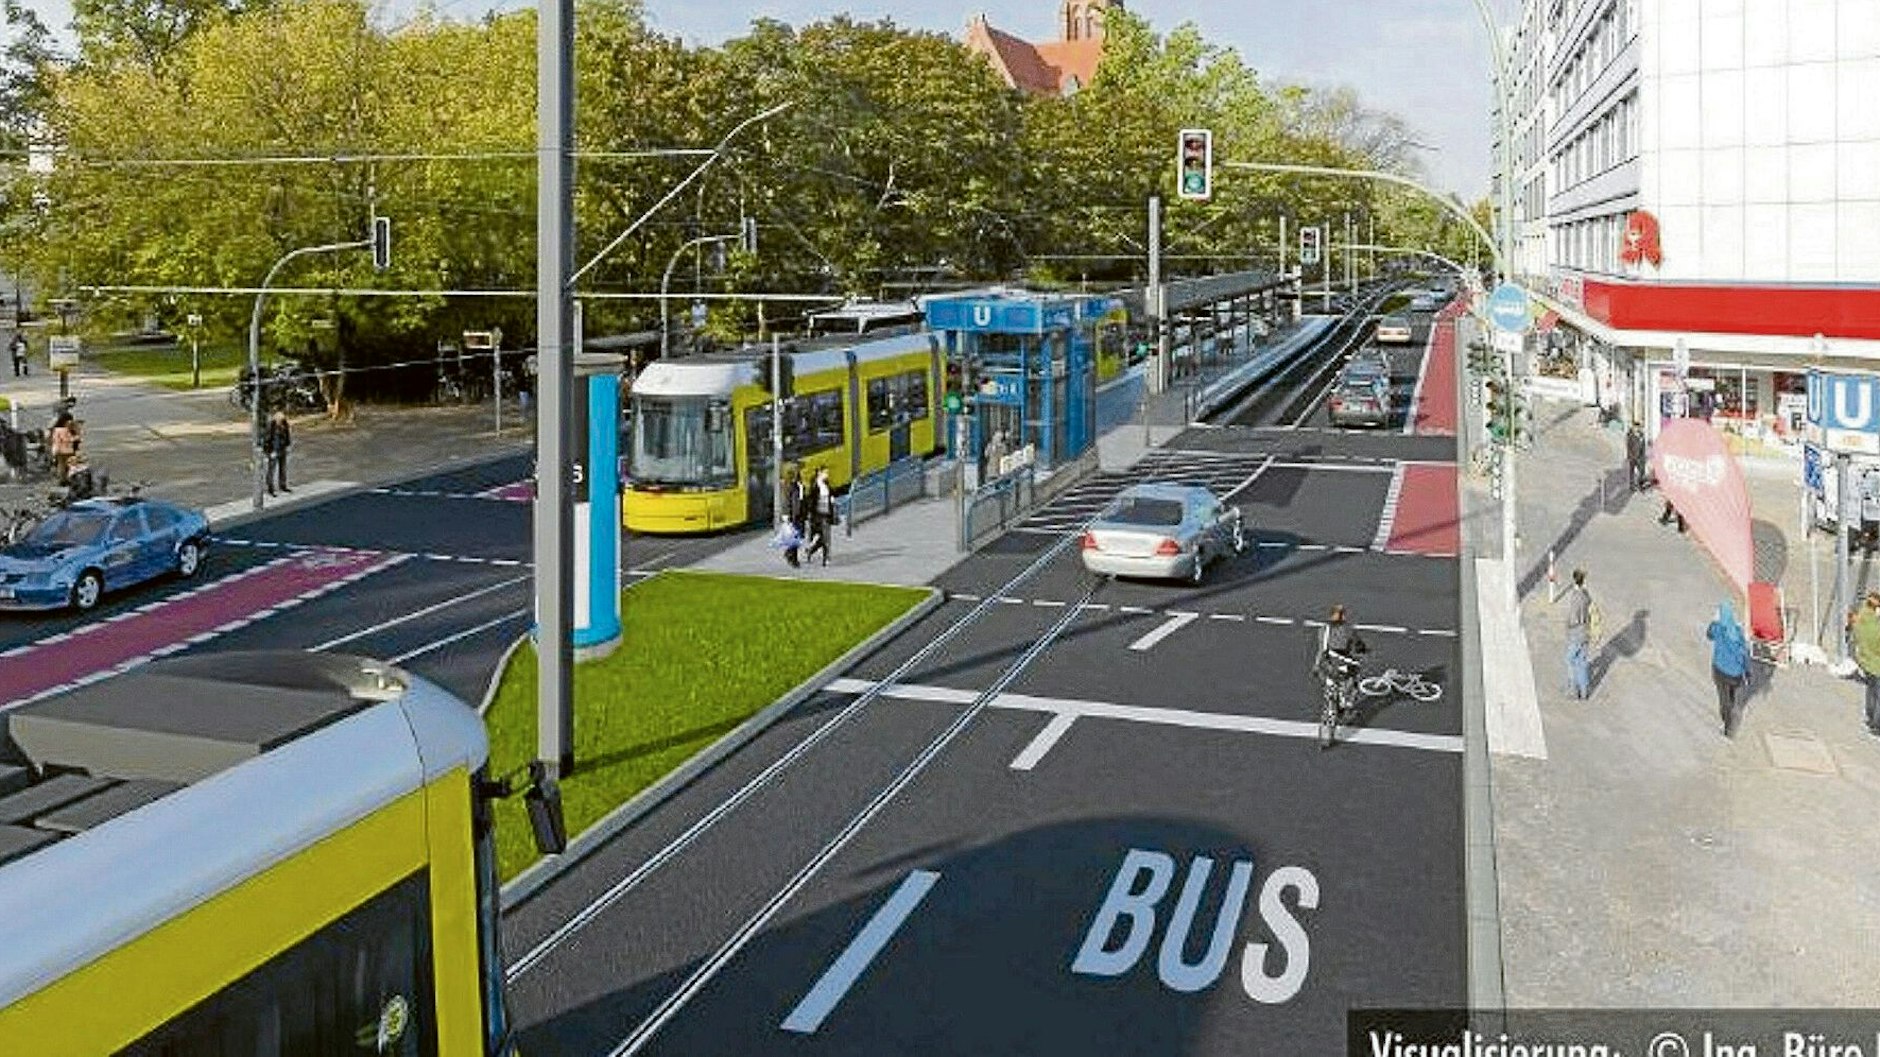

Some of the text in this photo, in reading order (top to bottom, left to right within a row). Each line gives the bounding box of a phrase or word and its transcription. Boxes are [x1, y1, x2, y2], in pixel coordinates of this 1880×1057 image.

[973, 306, 991, 326] U
[1835, 381, 1872, 428] U
[1072, 848, 1320, 1004] BUS
